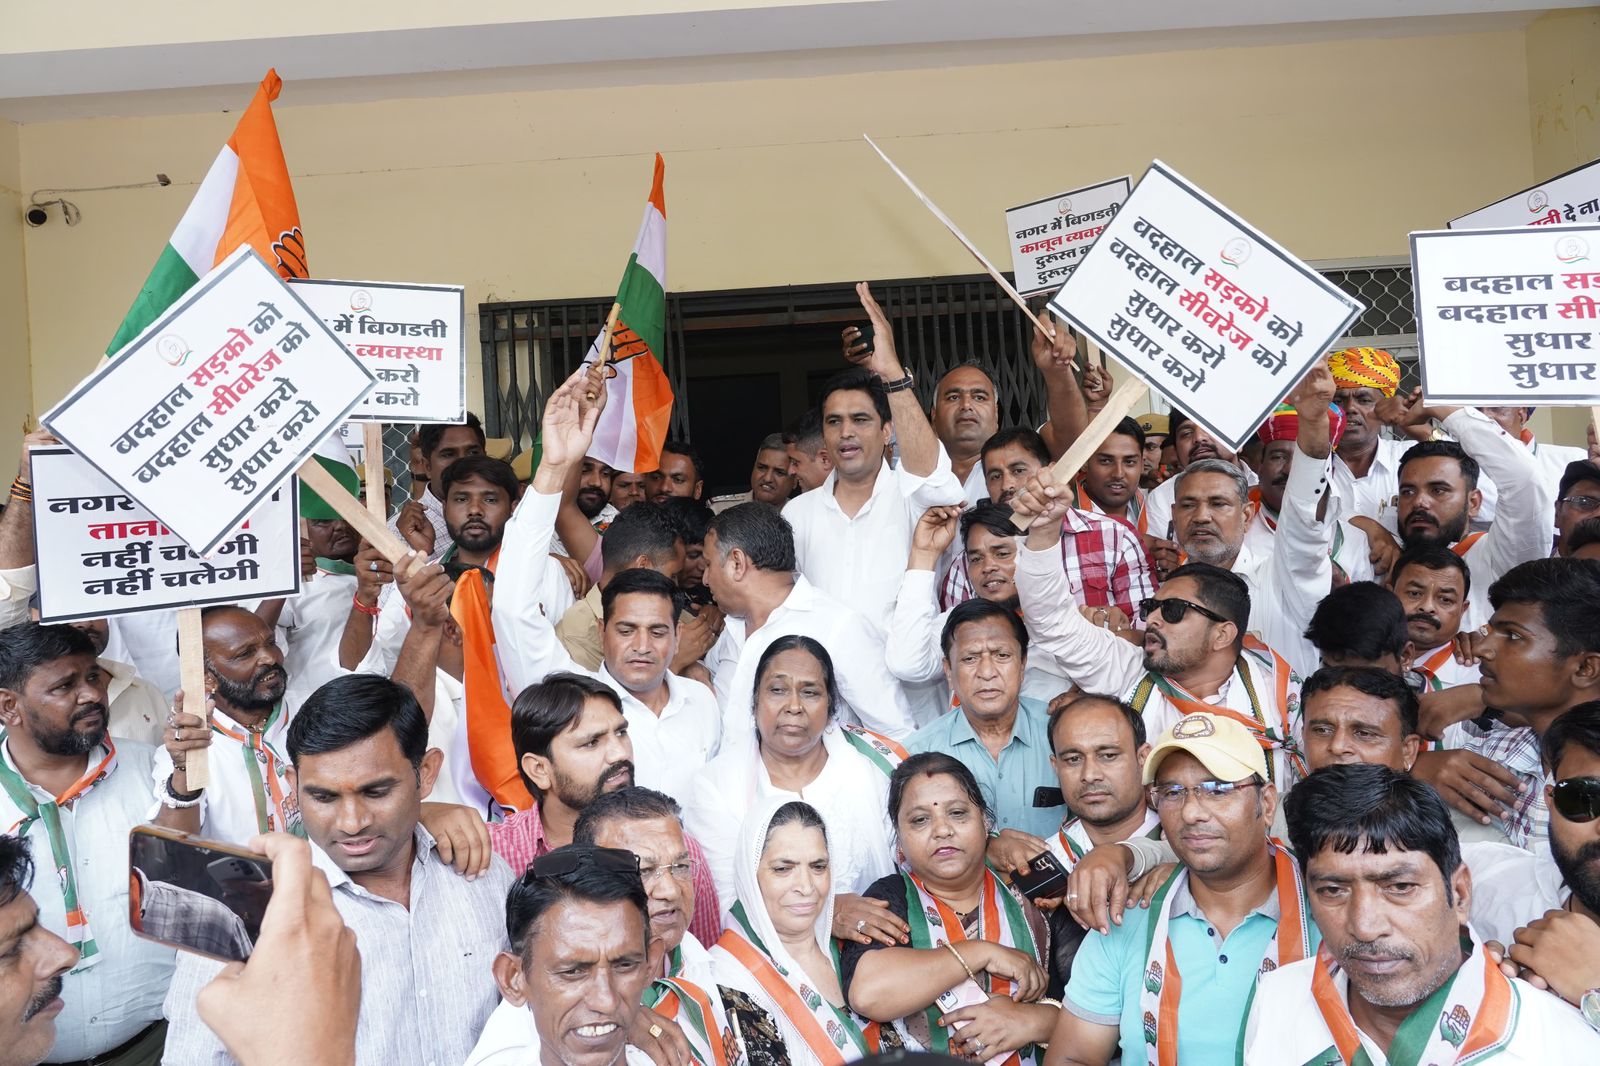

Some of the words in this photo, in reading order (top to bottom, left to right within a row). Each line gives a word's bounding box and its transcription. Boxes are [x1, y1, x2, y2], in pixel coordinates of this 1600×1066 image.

[1016, 224, 1048, 240] नगर
[1050, 216, 1062, 231] में
[1019, 236, 1063, 254] कानून
[1133, 216, 1205, 276] बदहाल
[1204, 267, 1269, 322] सड़को
[1266, 314, 1303, 348] को
[1443, 273, 1554, 294] बदहाल
[1109, 237, 1180, 297] बदहाल
[1178, 288, 1253, 351] सीवरेज
[1251, 343, 1287, 376] को
[1437, 303, 1548, 324] बदहाल
[333, 313, 355, 334] में
[358, 314, 448, 338] बिगडती
[1125, 289, 1183, 338] सुधार
[1181, 329, 1226, 369] करो
[355, 344, 444, 361] व्यवस्था
[1107, 313, 1164, 361] सुधार
[1162, 353, 1206, 393] करो
[1504, 332, 1592, 358] सुधार
[110, 383, 194, 454] बदहाल
[187, 327, 254, 387] सड़को
[248, 301, 284, 335] को
[375, 363, 421, 383] करो
[1507, 362, 1597, 389] सुधार
[132, 412, 214, 483] बदहाल
[207, 349, 282, 416] सीवरेज
[276, 320, 311, 354] को
[375, 386, 421, 406] करो
[200, 415, 257, 473] सुधार
[253, 376, 298, 419] करो
[224, 437, 283, 495] सुधार
[277, 399, 321, 441] करो
[81, 540, 153, 568] नहीं
[83, 567, 155, 595] नहीं
[160, 559, 260, 588] चलेगी
